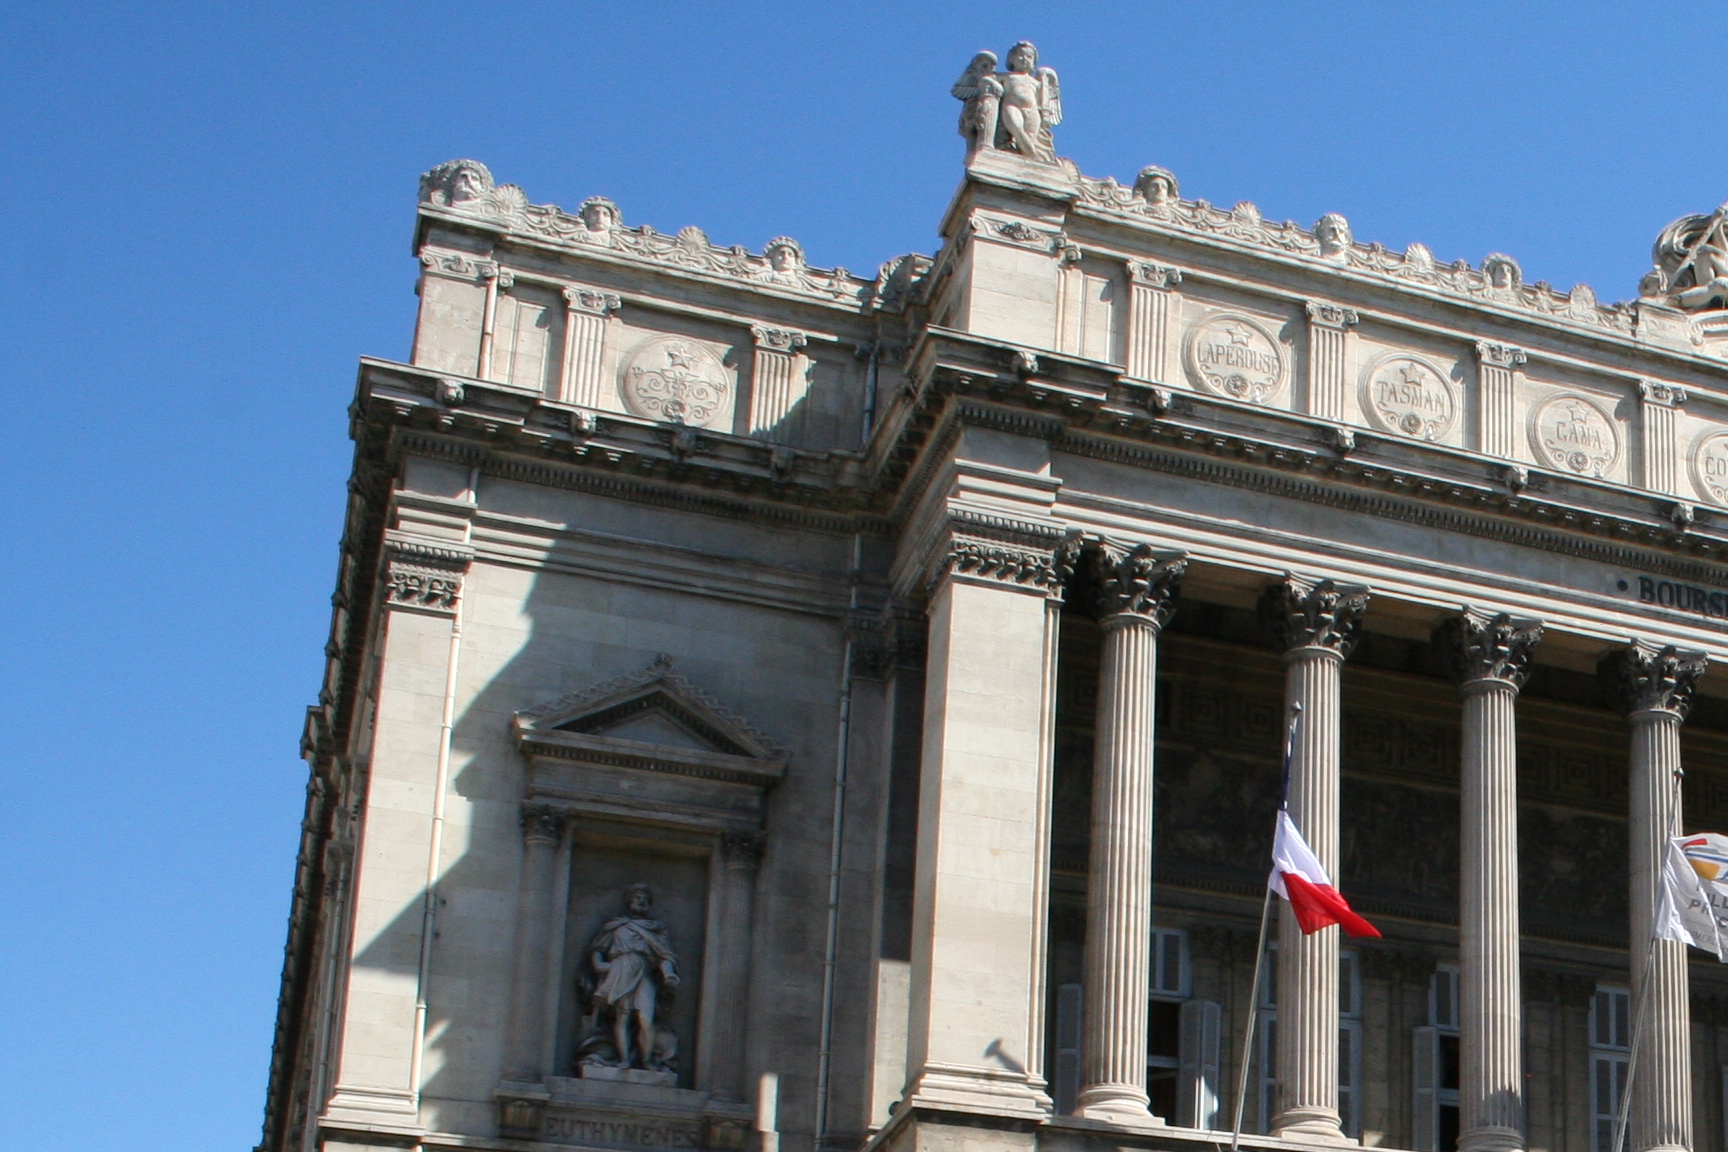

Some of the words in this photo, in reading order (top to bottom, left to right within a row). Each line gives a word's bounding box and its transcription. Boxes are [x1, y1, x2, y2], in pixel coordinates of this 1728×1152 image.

[1376, 381, 1446, 413] TASMAN
[1557, 421, 1602, 449] GAMA
[545, 1116, 699, 1149] EUTHYMENES
